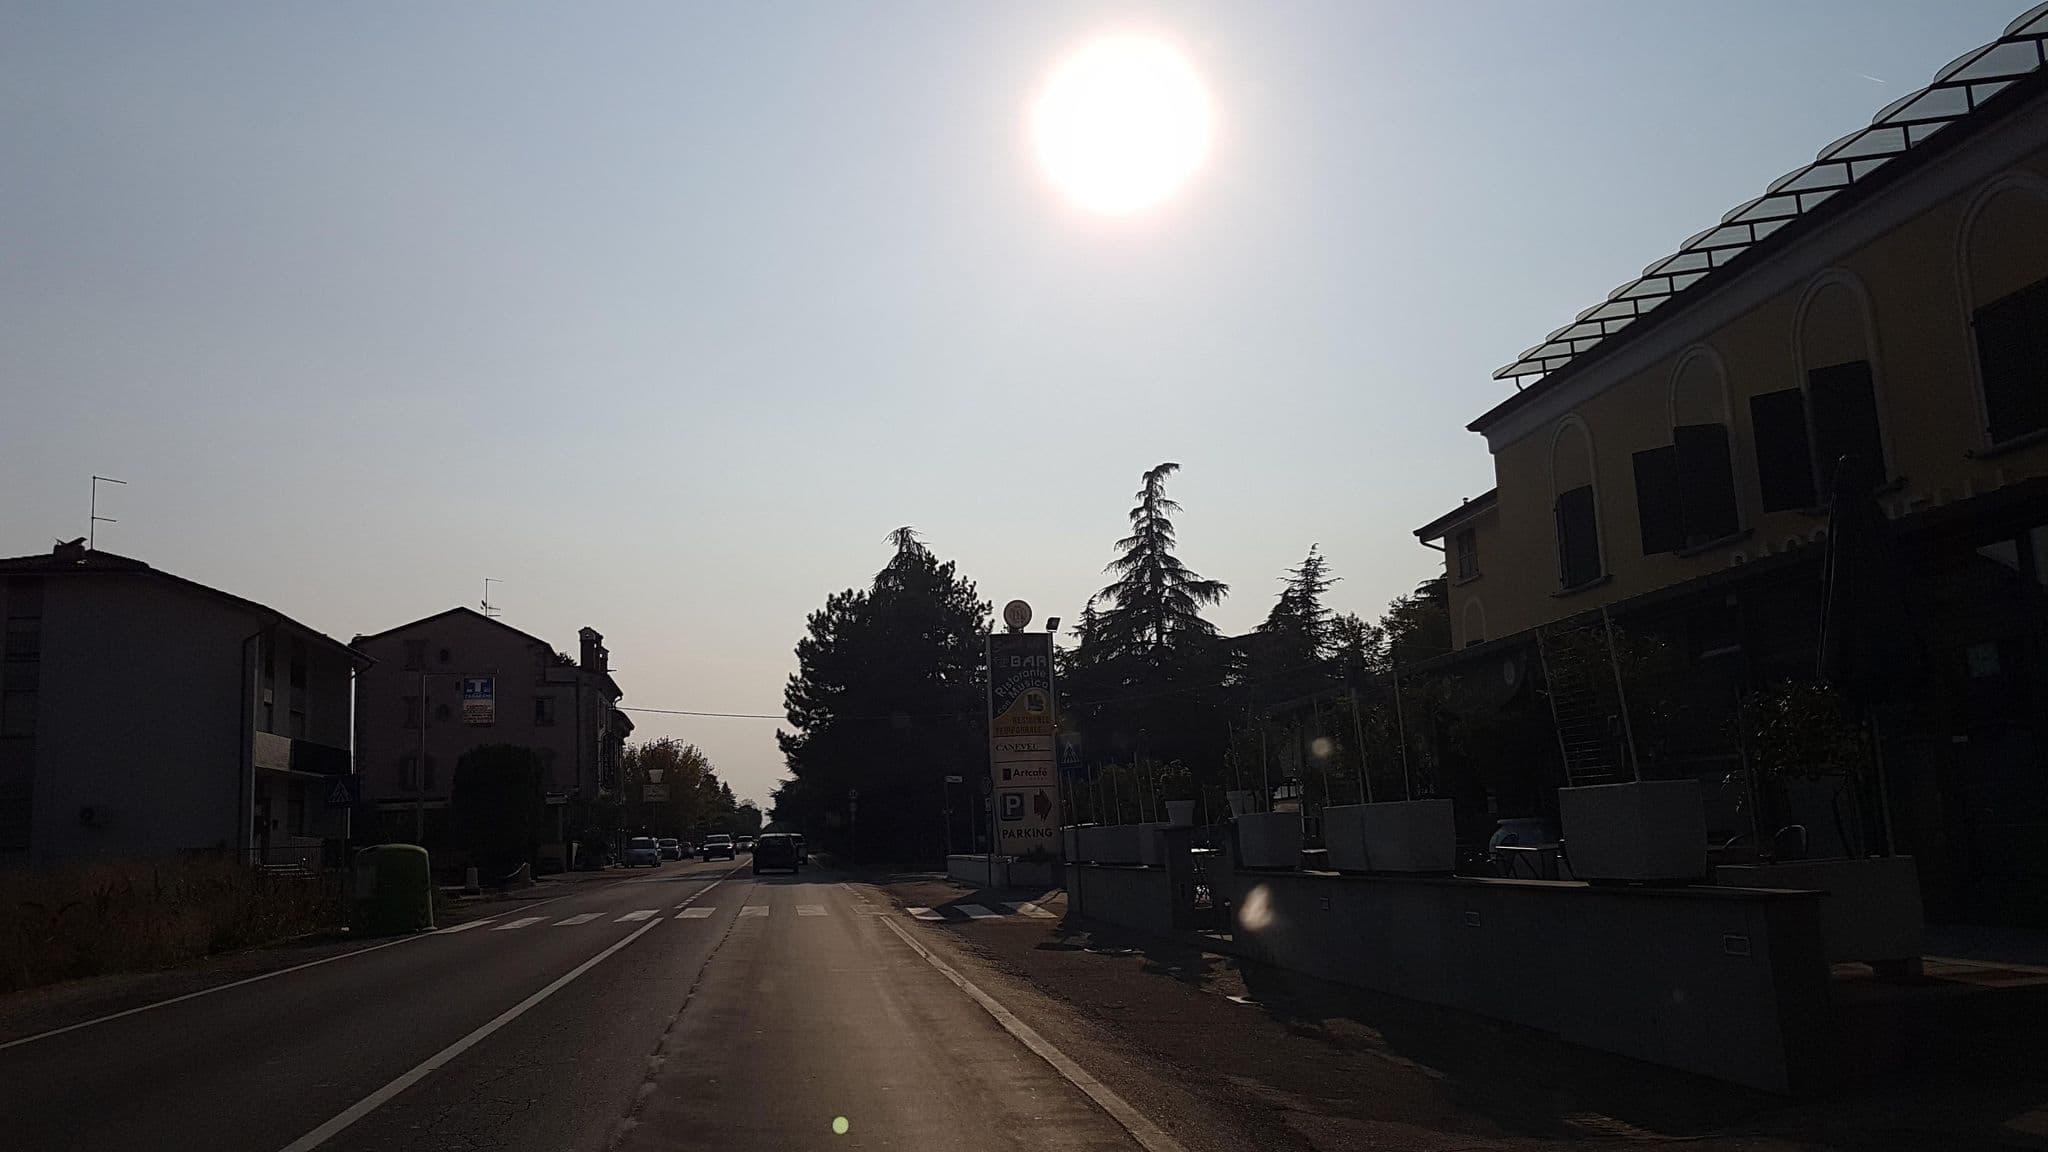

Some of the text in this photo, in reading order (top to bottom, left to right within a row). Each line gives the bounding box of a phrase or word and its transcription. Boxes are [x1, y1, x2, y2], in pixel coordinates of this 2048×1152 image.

[1010, 655, 1048, 667] BAR
[994, 667, 1047, 698] Ristorante
[1007, 679, 1049, 701] Musica
[1006, 795, 1021, 816] P
[1002, 828, 1053, 839] PARKING
